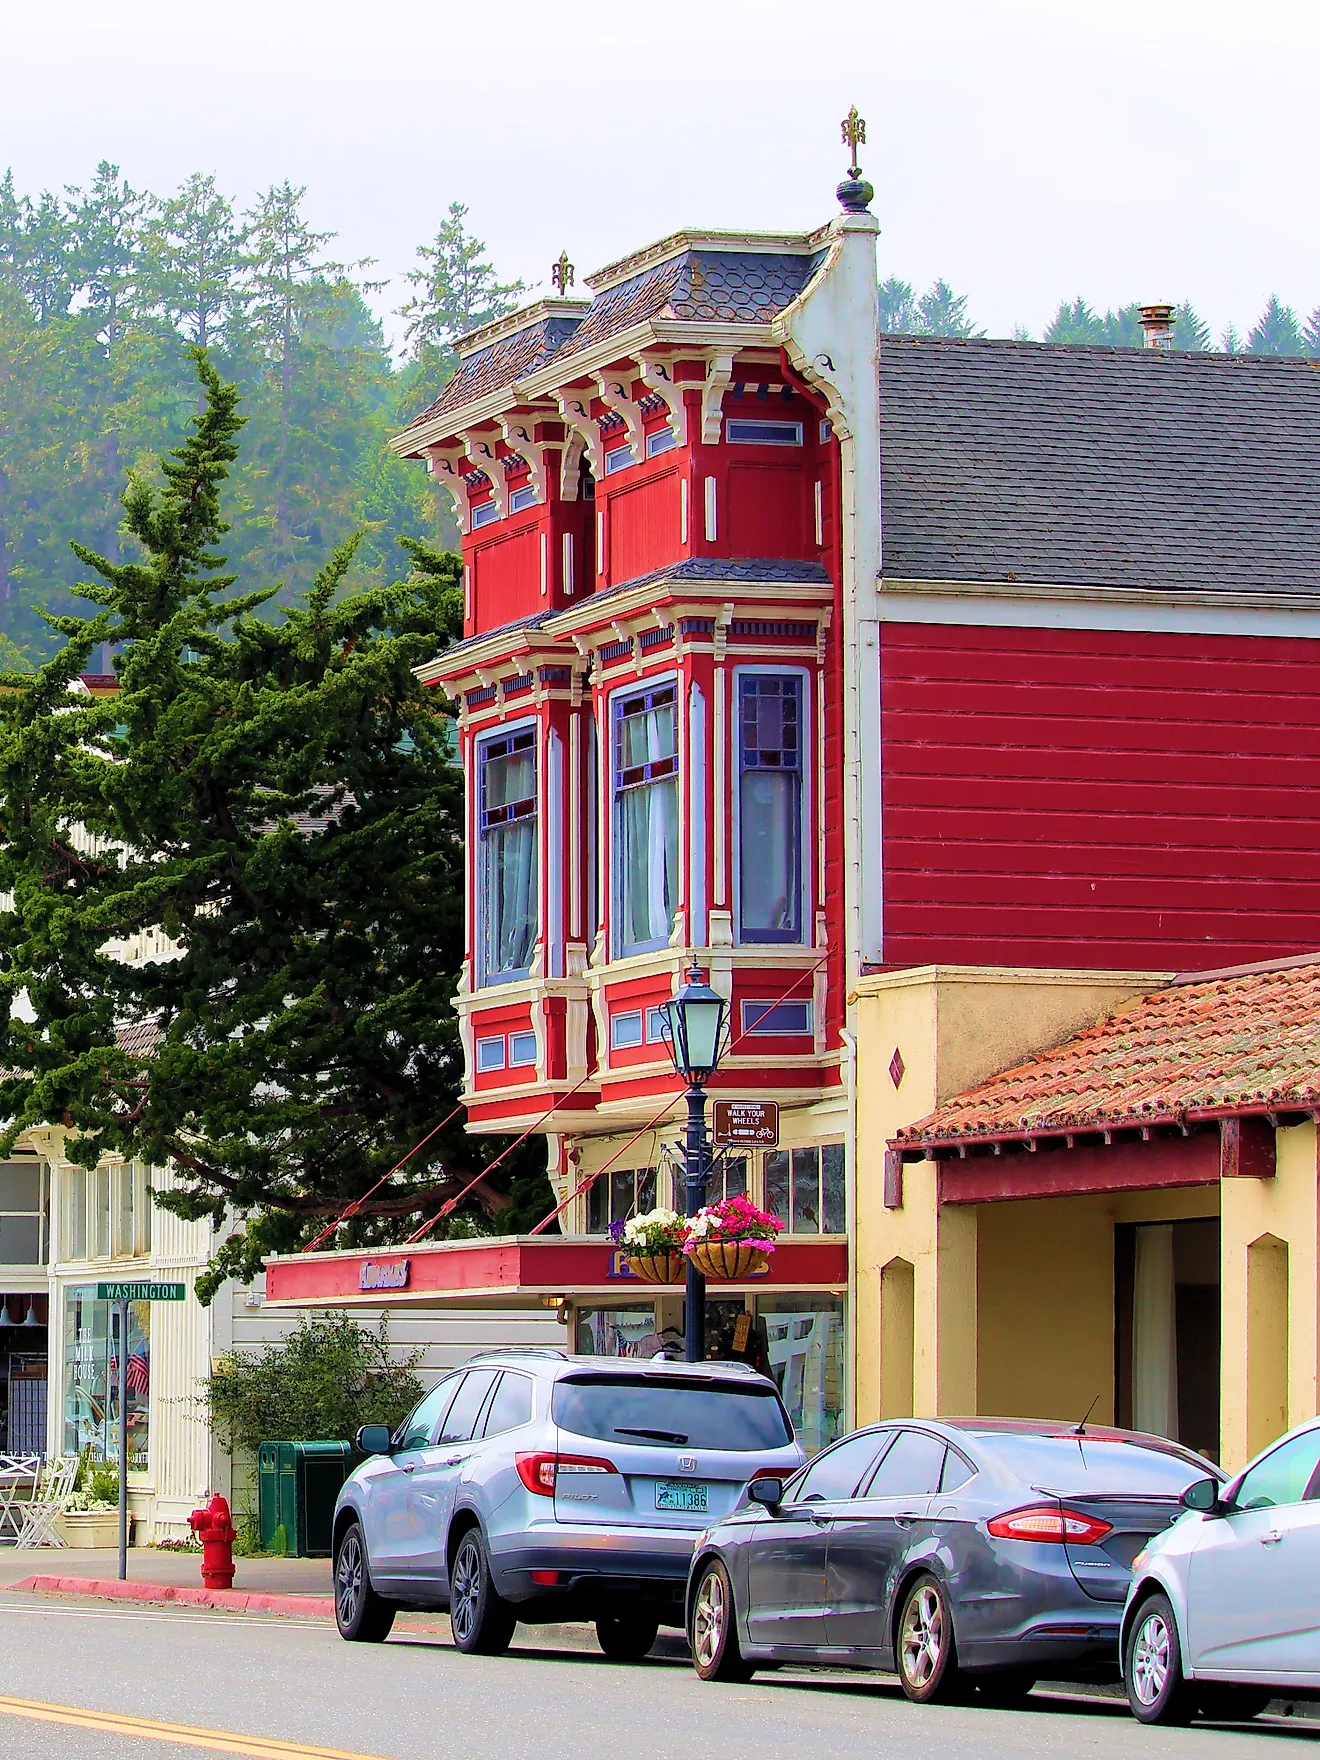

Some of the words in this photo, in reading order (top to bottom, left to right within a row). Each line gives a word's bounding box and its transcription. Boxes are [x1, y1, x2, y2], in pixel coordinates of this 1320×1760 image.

[727, 1109, 746, 1117] WALK
[747, 1110, 766, 1118] YOUR
[732, 1117, 760, 1125] WHEELS
[105, 1284, 177, 1299] WASHINGTON
[78, 1327, 91, 1343] THE
[75, 1345, 94, 1362] MILK
[73, 1364, 95, 1380] HOUSE
[561, 1493, 598, 1501] PILOT
[675, 1492, 707, 1506] 11386
